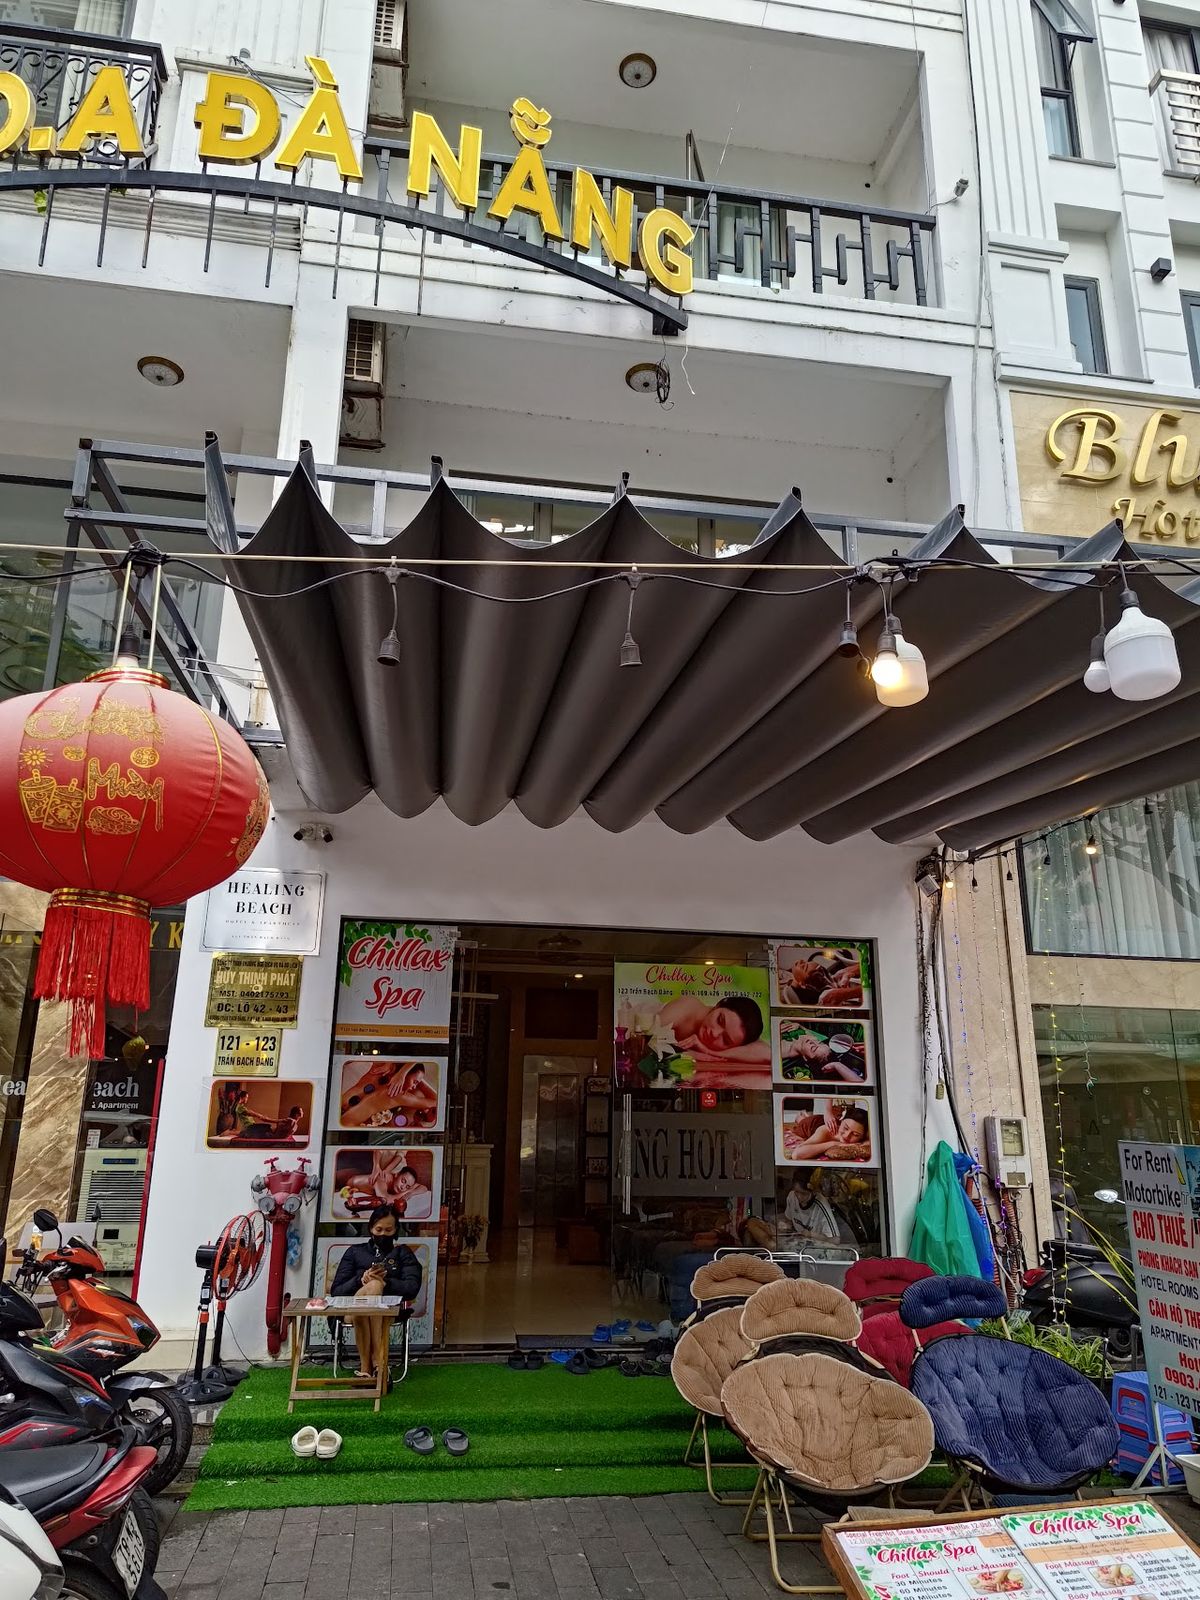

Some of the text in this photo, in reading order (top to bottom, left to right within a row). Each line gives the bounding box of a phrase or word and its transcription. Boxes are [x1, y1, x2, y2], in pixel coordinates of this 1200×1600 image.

[195, 55, 363, 184] ĐÀ
[407, 97, 695, 296] NẴNG
[227, 881, 305, 897] HEALING
[236, 901, 292, 915] BEACH
[347, 935, 452, 972] Chillax
[270, 969, 296, 987] PHÁT
[645, 965, 733, 989] Chillax Spa
[219, 990, 238, 998] MST:
[364, 976, 426, 1019] Spa
[237, 1002, 250, 1013] LÔ
[253, 1004, 266, 1014] 42
[276, 1005, 289, 1015] 43
[220, 1035, 241, 1051] 121
[255, 1036, 277, 1052] 123
[98, 1101, 140, 1110] Apartment
[615, 1128, 669, 1180] NG
[1123, 1148, 1173, 1174] For Rent
[1124, 1179, 1182, 1208] Motorbike
[1132, 1210, 1156, 1241] CHO
[1157, 1212, 1189, 1248] THUÊ
[1160, 1252, 1183, 1275] KHÁCH
[1183, 1259, 1199, 1281] SẠN
[1140, 1274, 1199, 1300] HOTEL ROOMS
[1148, 1297, 1169, 1320] CĂN
[1169, 1302, 1183, 1328] HỘ
[1165, 1366, 1200, 1391] 0903.
[1153, 1384, 1168, 1400] 121
[1175, 1392, 1190, 1410] 123
[916, 1526, 945, 1535] Massage
[1029, 1512, 1141, 1535] Chillax Spa
[877, 1543, 976, 1563] Chillax Spa
[891, 1572, 910, 1580] Foot
[918, 1569, 949, 1578] Should
[957, 1565, 978, 1573] Neck
[981, 1561, 1018, 1571] Massage
[1044, 1559, 1099, 1570] Foot Massage
[908, 1578, 943, 1586] Minutes
[913, 1585, 948, 1594] Minutes
[1065, 1576, 1086, 1584] Minutes
[1071, 1584, 1093, 1592] Minutes
[917, 1592, 953, 1600] Minutes
[1067, 1592, 1089, 1600] Body
[1090, 1587, 1127, 1599] Massage
